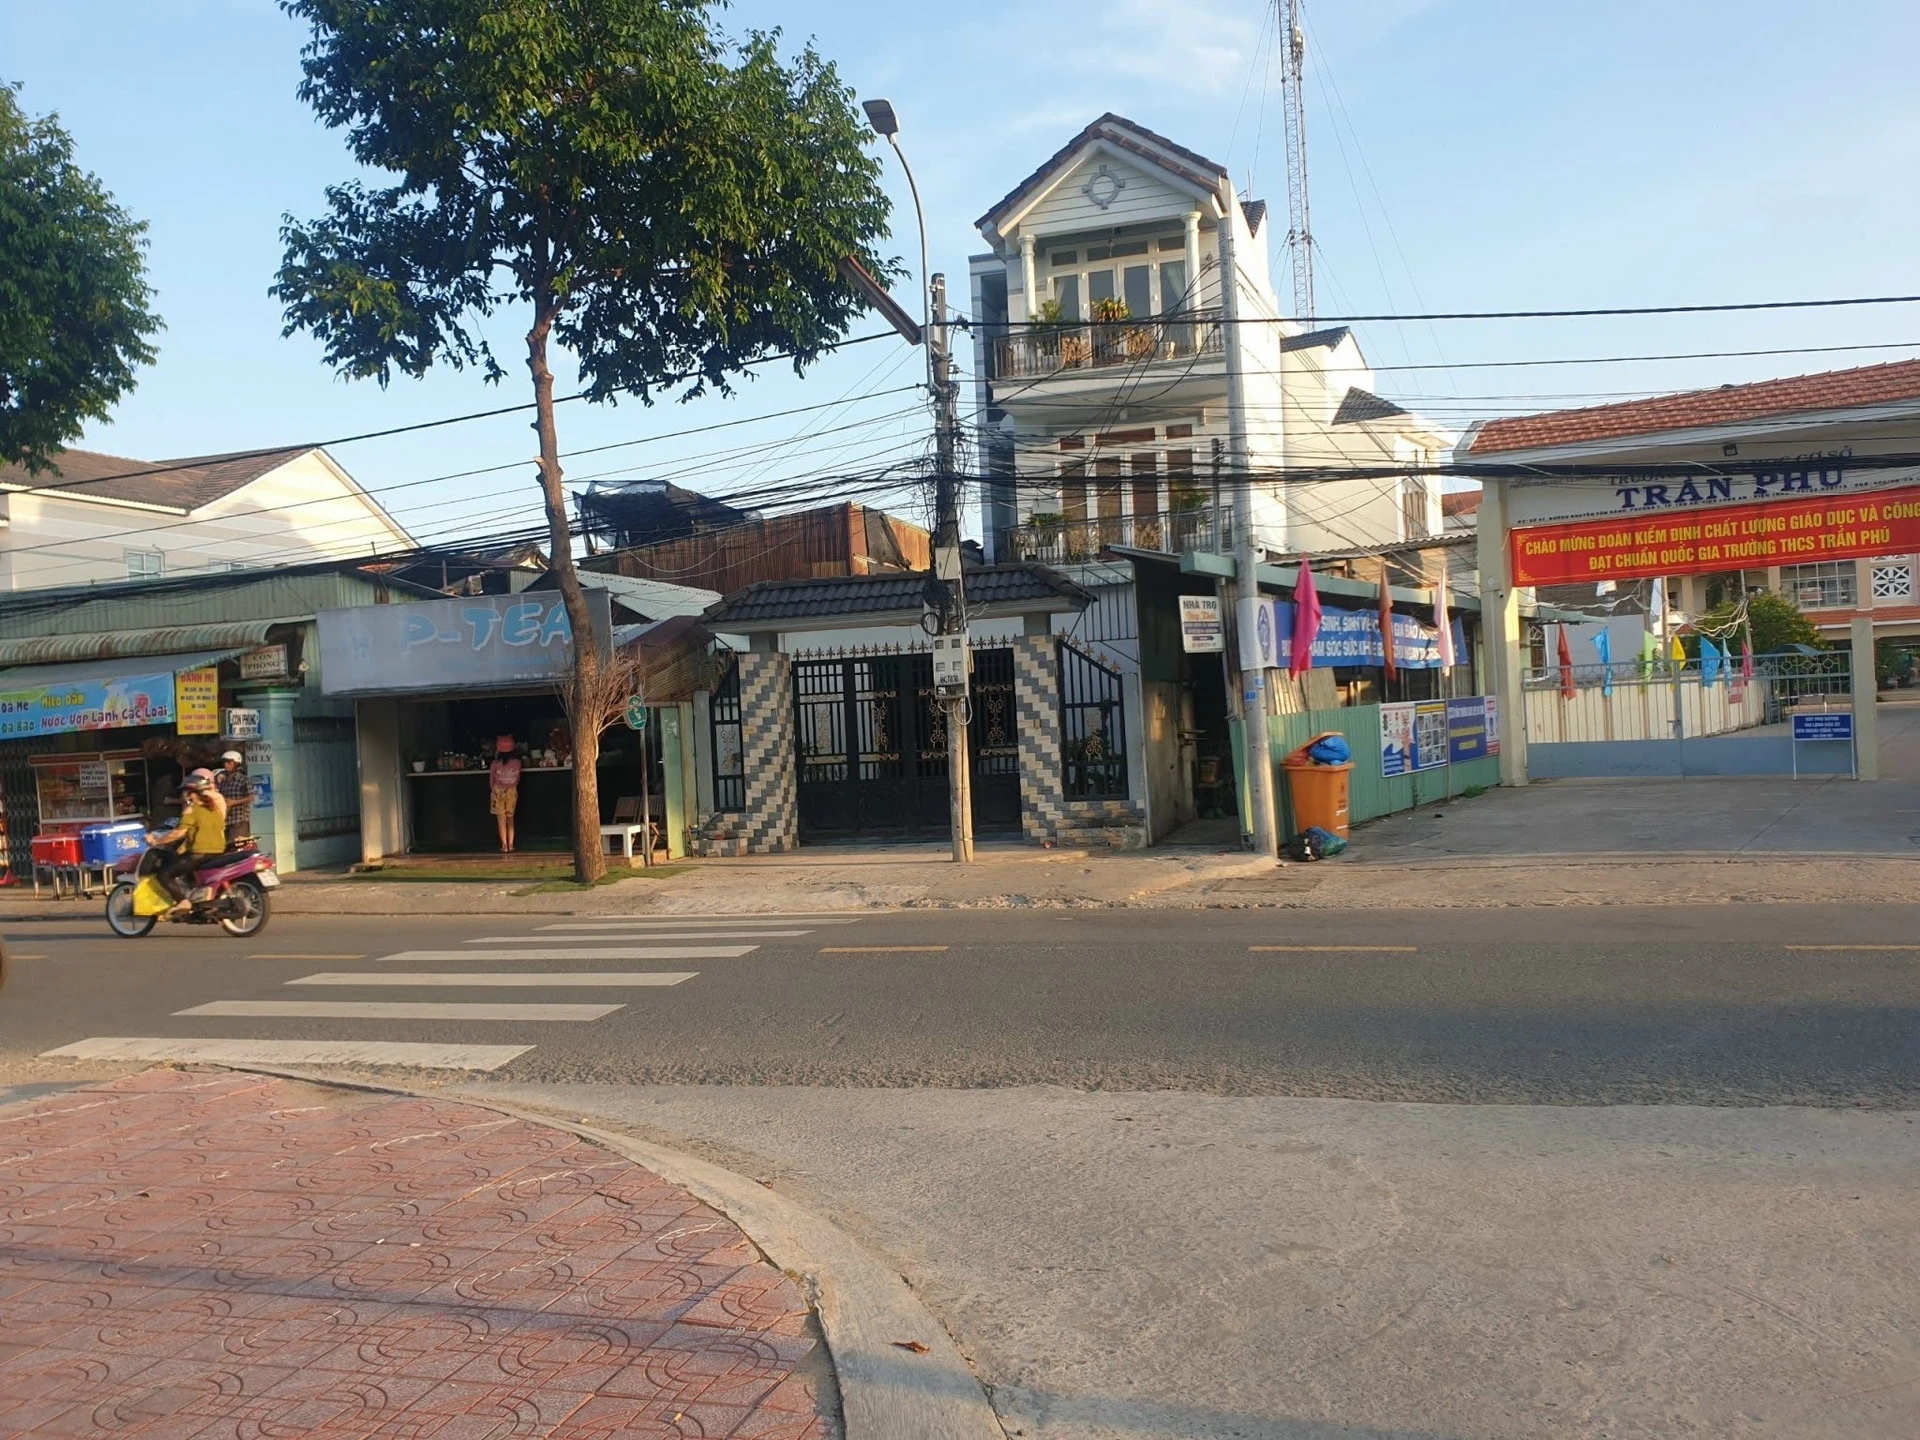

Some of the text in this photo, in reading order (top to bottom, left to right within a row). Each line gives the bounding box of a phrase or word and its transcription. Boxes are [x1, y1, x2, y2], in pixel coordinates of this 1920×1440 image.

[1526, 538, 1556, 555] CHÀO
[1560, 535, 1595, 552] MỪNG
[1599, 531, 1632, 548] ĐOÀN
[1635, 525, 1667, 545] KIỂM
[1670, 527, 1701, 544] ĐỊNH
[1704, 517, 1737, 538] CHẤT
[1742, 516, 1786, 536] LƯỢNG
[1790, 511, 1822, 530] GIÁO
[1827, 509, 1855, 528] DỤC
[1859, 504, 1879, 522] VÀ
[1589, 526, 1891, 572] ĐẠT CHUẨN QUỐC GIA TRƯỜNG THCS TRẦN PHÚ
